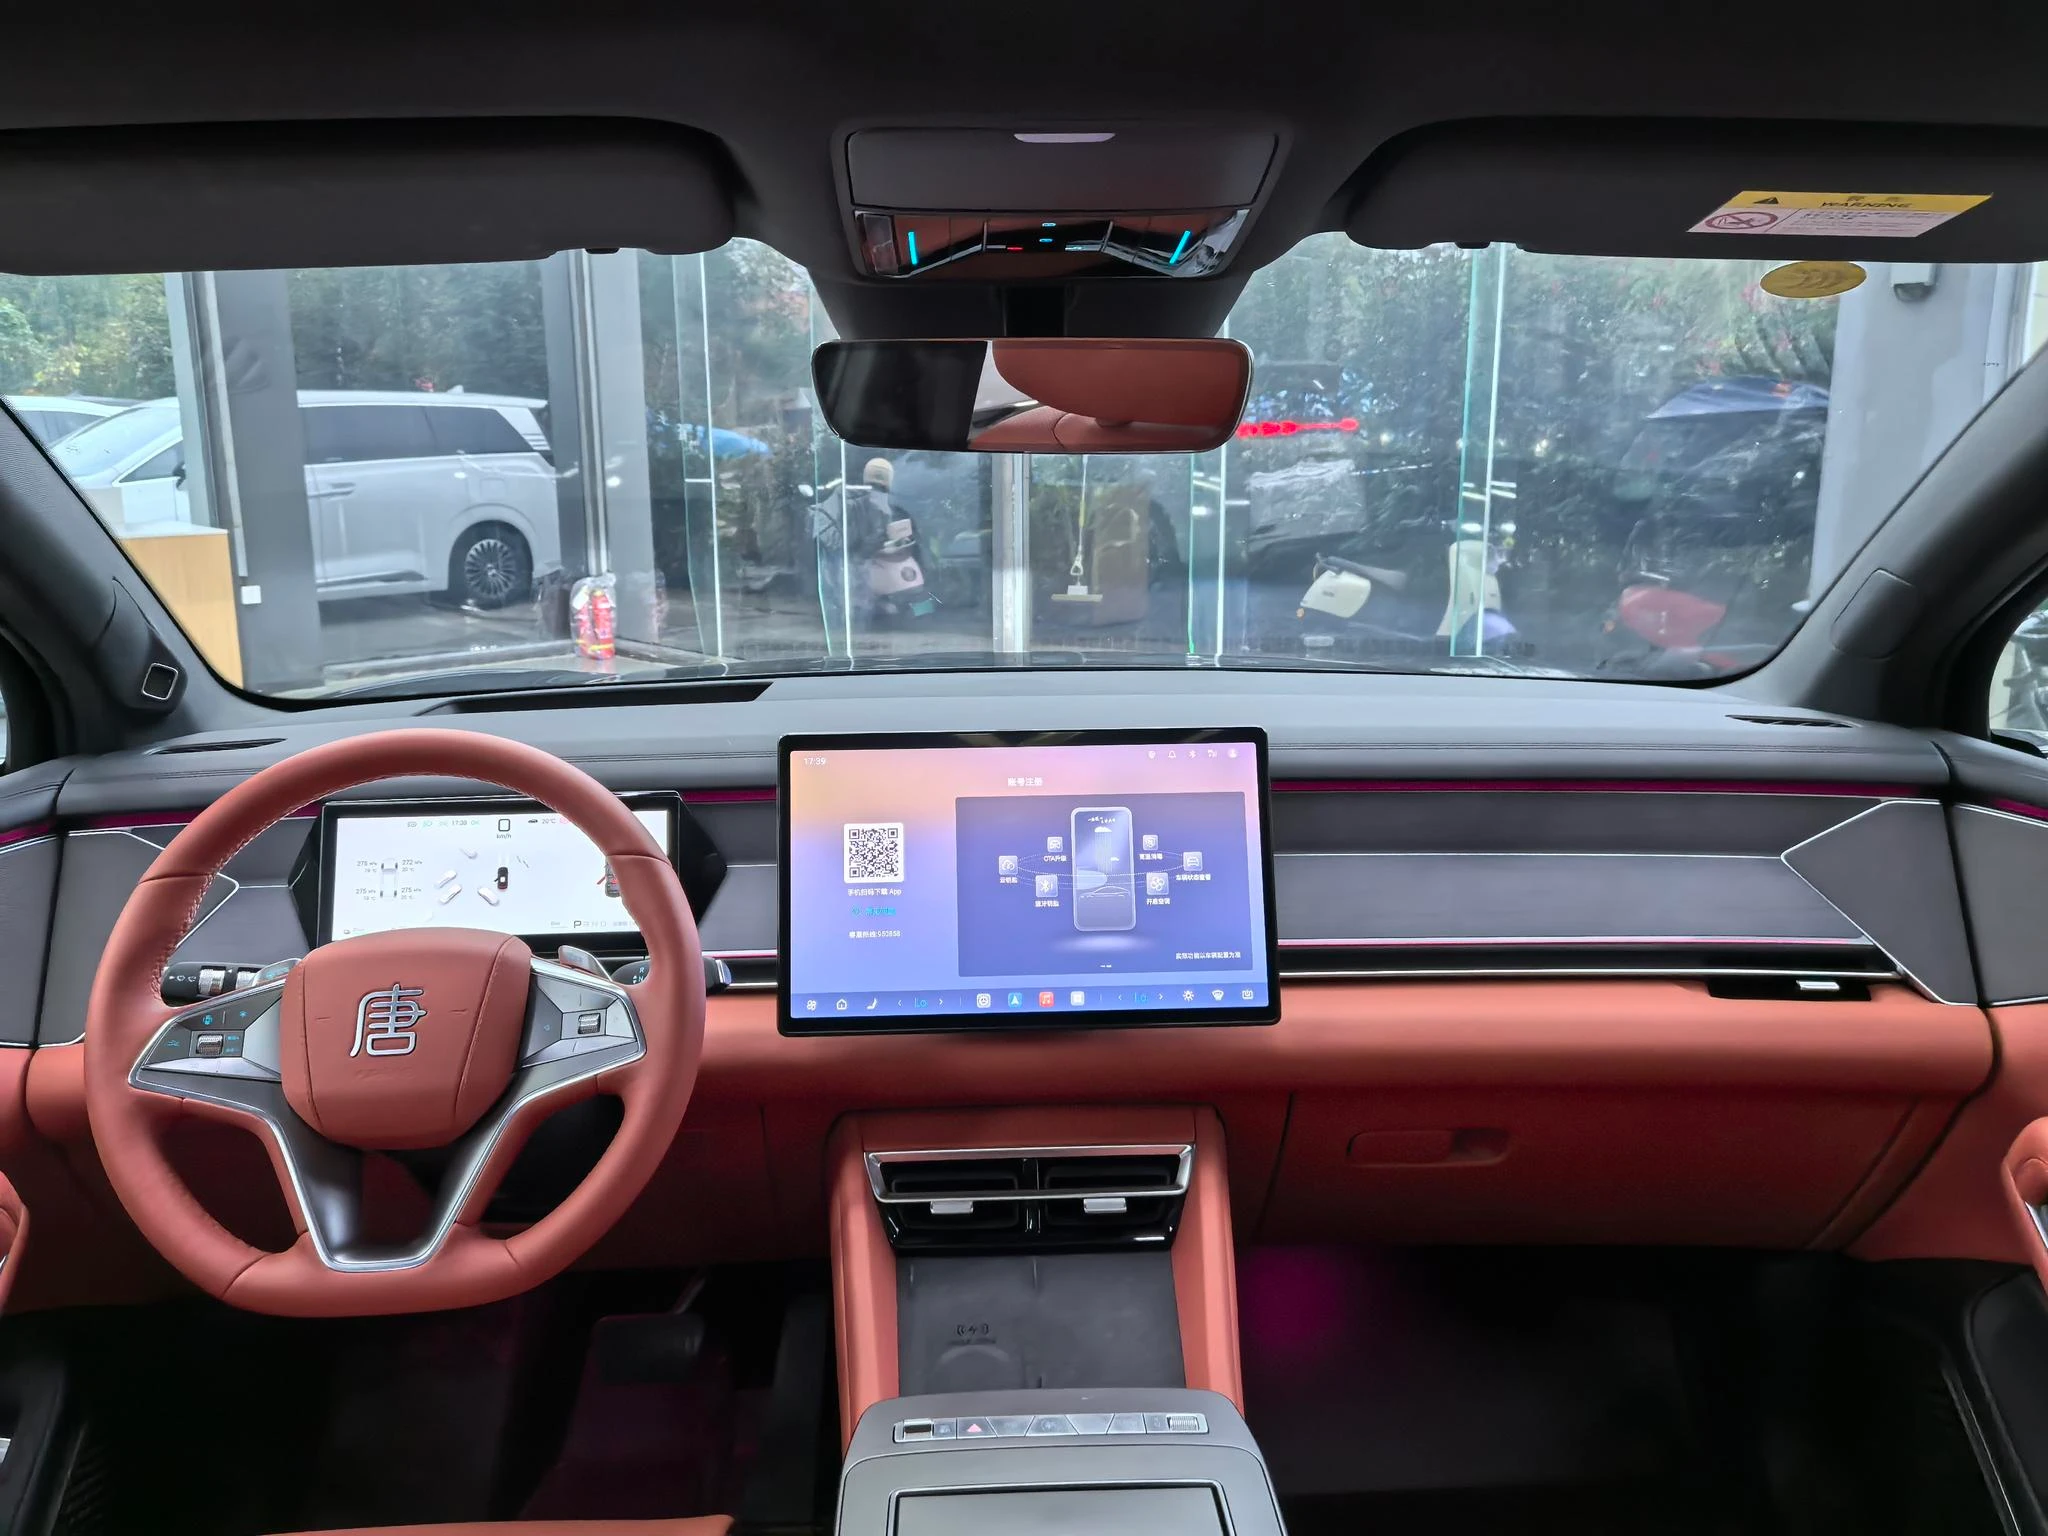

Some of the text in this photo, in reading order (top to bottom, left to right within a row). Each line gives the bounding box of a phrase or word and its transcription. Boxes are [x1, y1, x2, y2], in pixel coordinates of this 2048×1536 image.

[804, 757, 826, 766] 17:39
[889, 888, 902, 896] App
[574, 920, 581, 928] P
